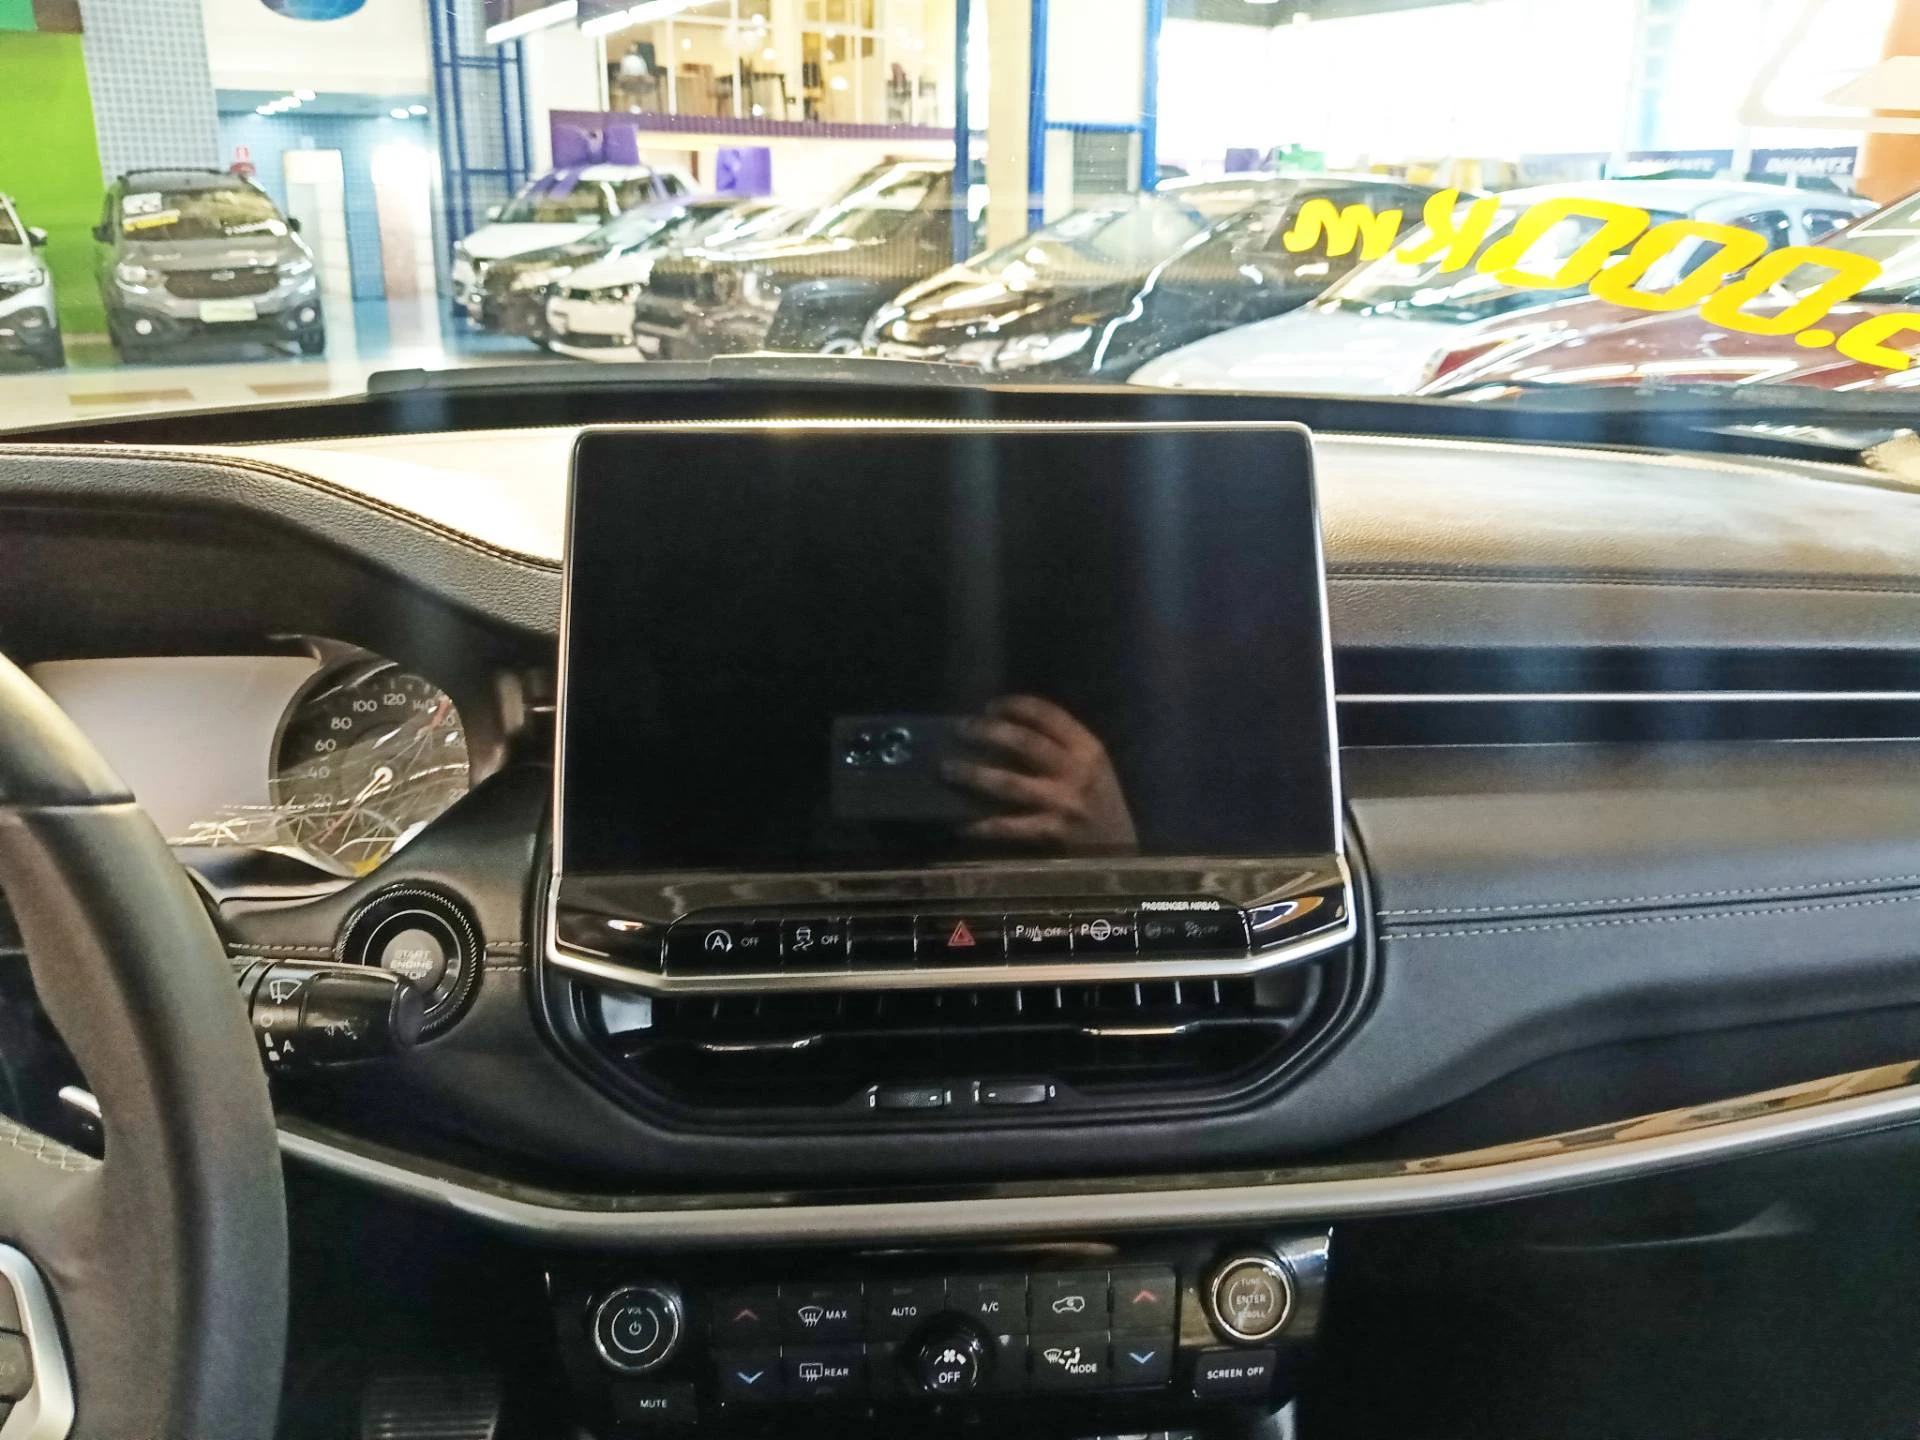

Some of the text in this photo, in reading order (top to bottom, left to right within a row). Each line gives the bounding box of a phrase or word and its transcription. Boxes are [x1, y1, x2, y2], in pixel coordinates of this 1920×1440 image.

[383, 693, 407, 706] 120
[353, 699, 378, 712] 100
[331, 717, 353, 729] 80
[315, 738, 337, 751] 60
[308, 766, 330, 778] 40
[1141, 901, 1220, 911] PASSENGER AIRBAG
[1044, 927, 1062, 937] OFF
[1112, 926, 1128, 937] ON
[740, 936, 759, 947] OFF
[821, 935, 840, 946] OFF
[397, 968, 427, 980] TOP
[1236, 1293, 1266, 1305] ENTER
[627, 1306, 643, 1315] VOL
[891, 1307, 917, 1317] AUTO
[981, 1301, 1000, 1312] A/C
[825, 1309, 848, 1320] MAX
[824, 1367, 850, 1378] REAR
[1070, 1363, 1098, 1375] MODE
[1206, 1366, 1265, 1380] SCREEN OFF
[938, 1371, 961, 1384] OFF
[640, 1399, 668, 1409] MUTE
